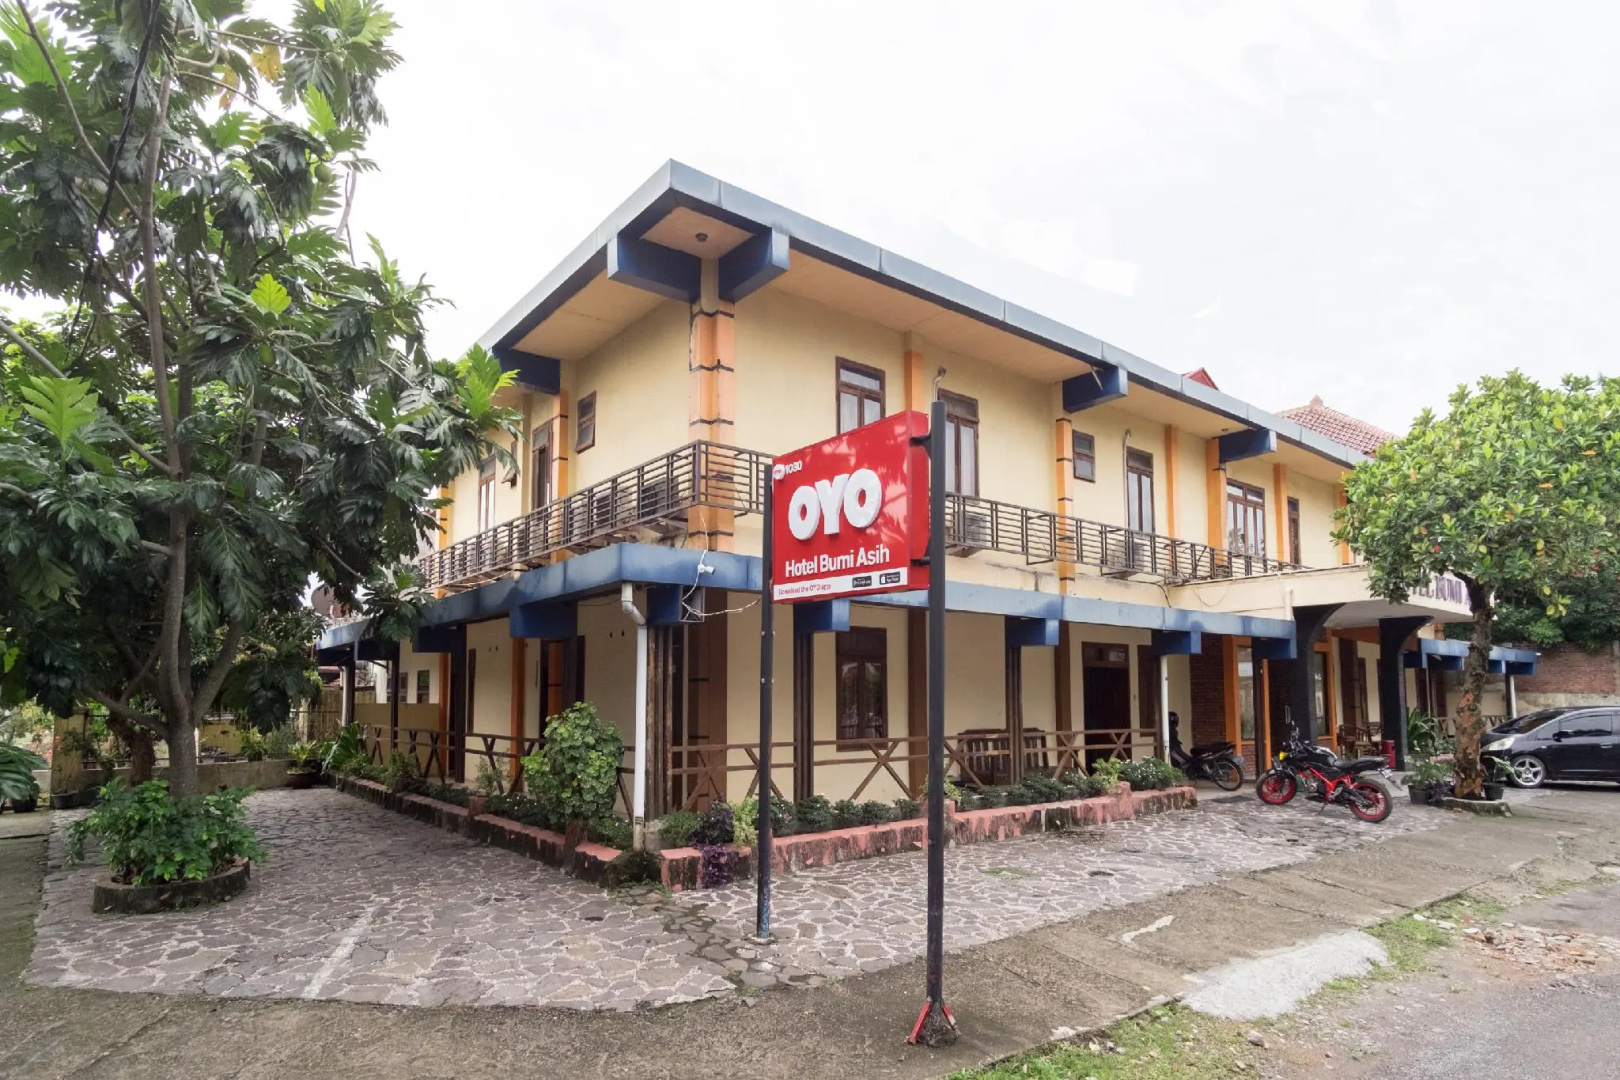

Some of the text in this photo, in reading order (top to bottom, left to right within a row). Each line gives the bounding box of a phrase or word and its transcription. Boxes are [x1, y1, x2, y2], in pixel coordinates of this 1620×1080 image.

[785, 460, 803, 475] 1030
[788, 468, 882, 541] OYO
[785, 543, 890, 578] Hotel Bumi Asih
